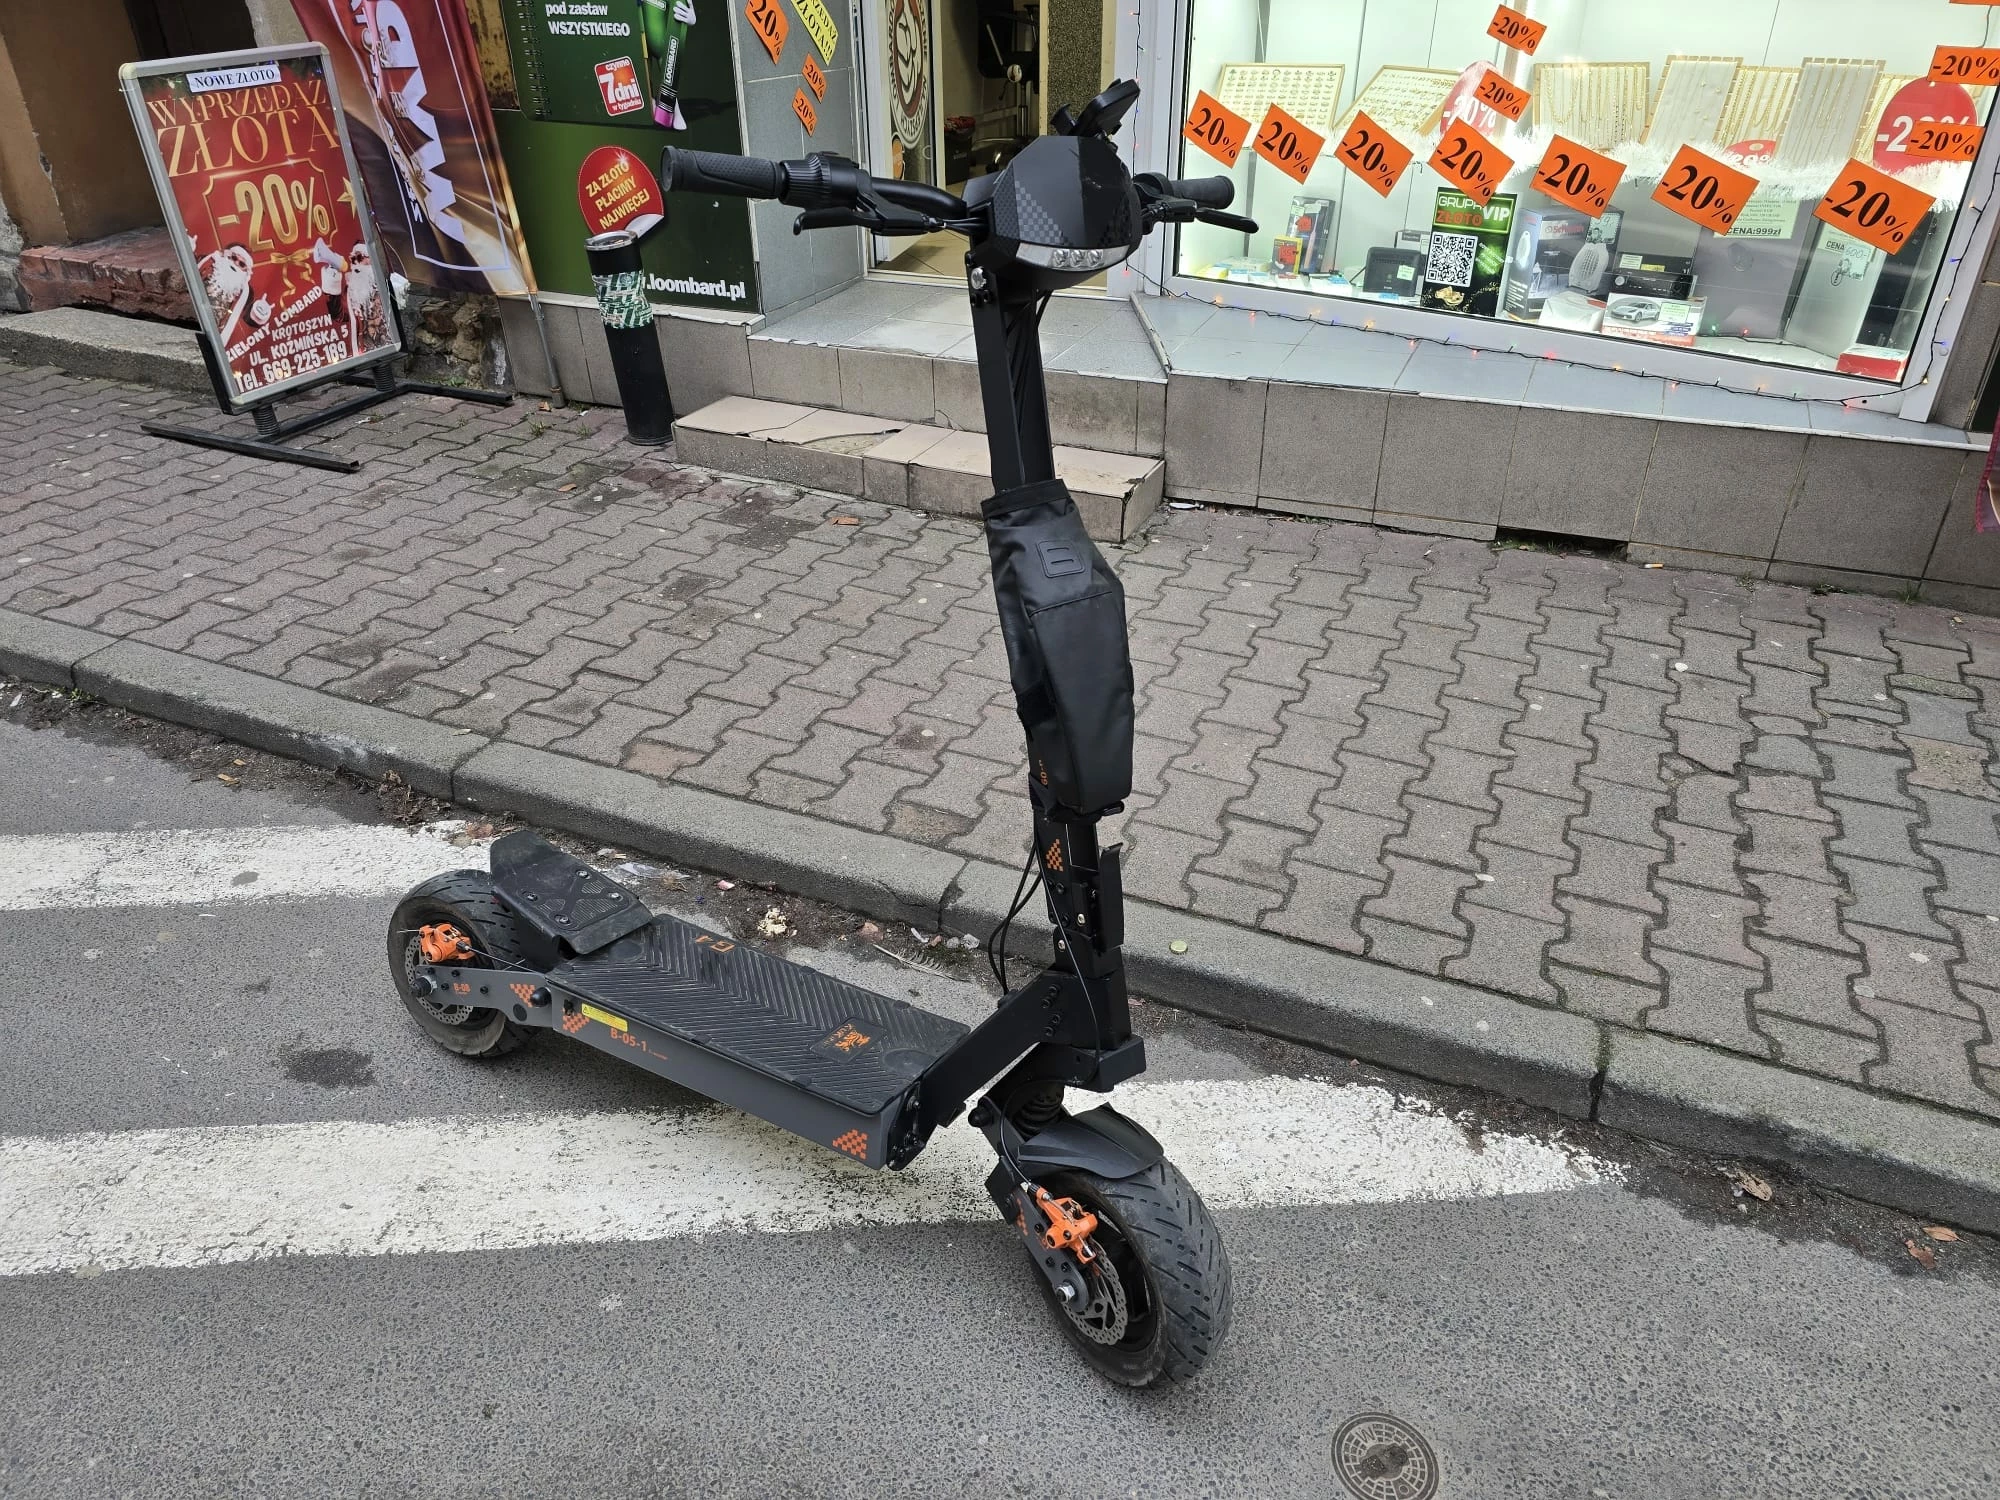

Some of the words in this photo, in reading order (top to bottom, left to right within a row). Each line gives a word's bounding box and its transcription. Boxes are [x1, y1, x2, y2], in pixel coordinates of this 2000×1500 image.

[545, 1, 566, 16] pod
[569, 2, 608, 15] zastaw
[548, 20, 631, 36] WSZYSTKIEGO
[750, 0, 782, 56] -20%
[1493, 16, 1536, 49] -20%
[194, 73, 234, 88] NOWE
[235, 69, 275, 84] ZŁOTO
[665, 38, 677, 84] LOOMBARD
[804, 63, 825, 98] -20%
[1932, 54, 1999, 79] -20%
[599, 72, 616, 104] 7
[614, 78, 640, 102] dni
[617, 99, 642, 110] tygodniu
[1479, 81, 1520, 115] -20%
[795, 98, 814, 131] -20%
[1188, 107, 1236, 159] -20%
[157, 105, 340, 177] ZŁOTA
[1258, 121, 1309, 174] -20%
[1342, 129, 1395, 188] -20%
[1910, 130, 1975, 155] -20%
[585, 181, 601, 197] ZA
[599, 161, 630, 186] ZŁOTO
[1436, 137, 1493, 197] -20%
[1538, 153, 1606, 208] -20%
[217, 173, 330, 252] -20%
[595, 176, 638, 211] PŁACIMY
[599, 188, 650, 230] NAJWIĘCEJ
[1661, 164, 1735, 224] -20%
[1824, 180, 1906, 243] -20%
[1482, 206, 1510, 222] VIP
[226, 323, 271, 363] ZIELONY
[274, 285, 323, 327] LOMBARD
[271, 313, 333, 341] KROTOSZYN
[249, 350, 269, 367] UL.
[341, 324, 349, 338] 5
[234, 369, 263, 393] Tel.
[262, 340, 348, 383] 669-225-189
